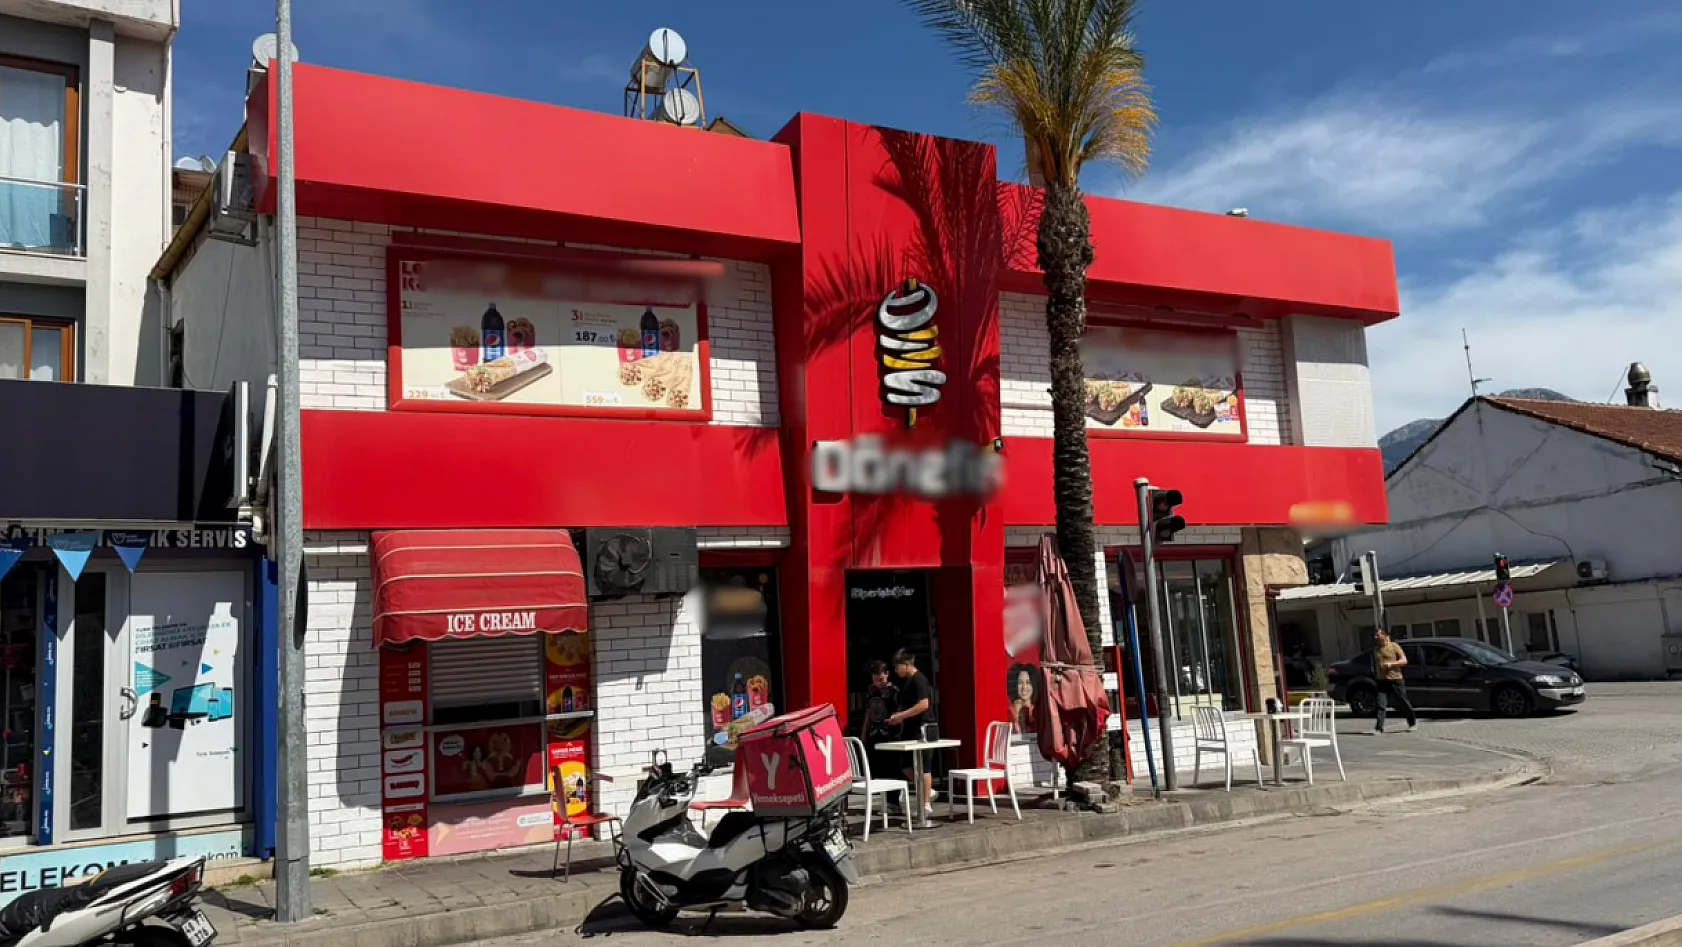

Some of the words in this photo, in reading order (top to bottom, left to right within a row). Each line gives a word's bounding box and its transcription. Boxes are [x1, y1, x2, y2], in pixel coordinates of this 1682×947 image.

[176, 527, 247, 548] SERVİS
[447, 613, 475, 632] ICE
[480, 611, 537, 631] CREAM
[816, 734, 832, 775] Y
[761, 751, 780, 790] Y
[752, 792, 805, 805] Yemeksepeti
